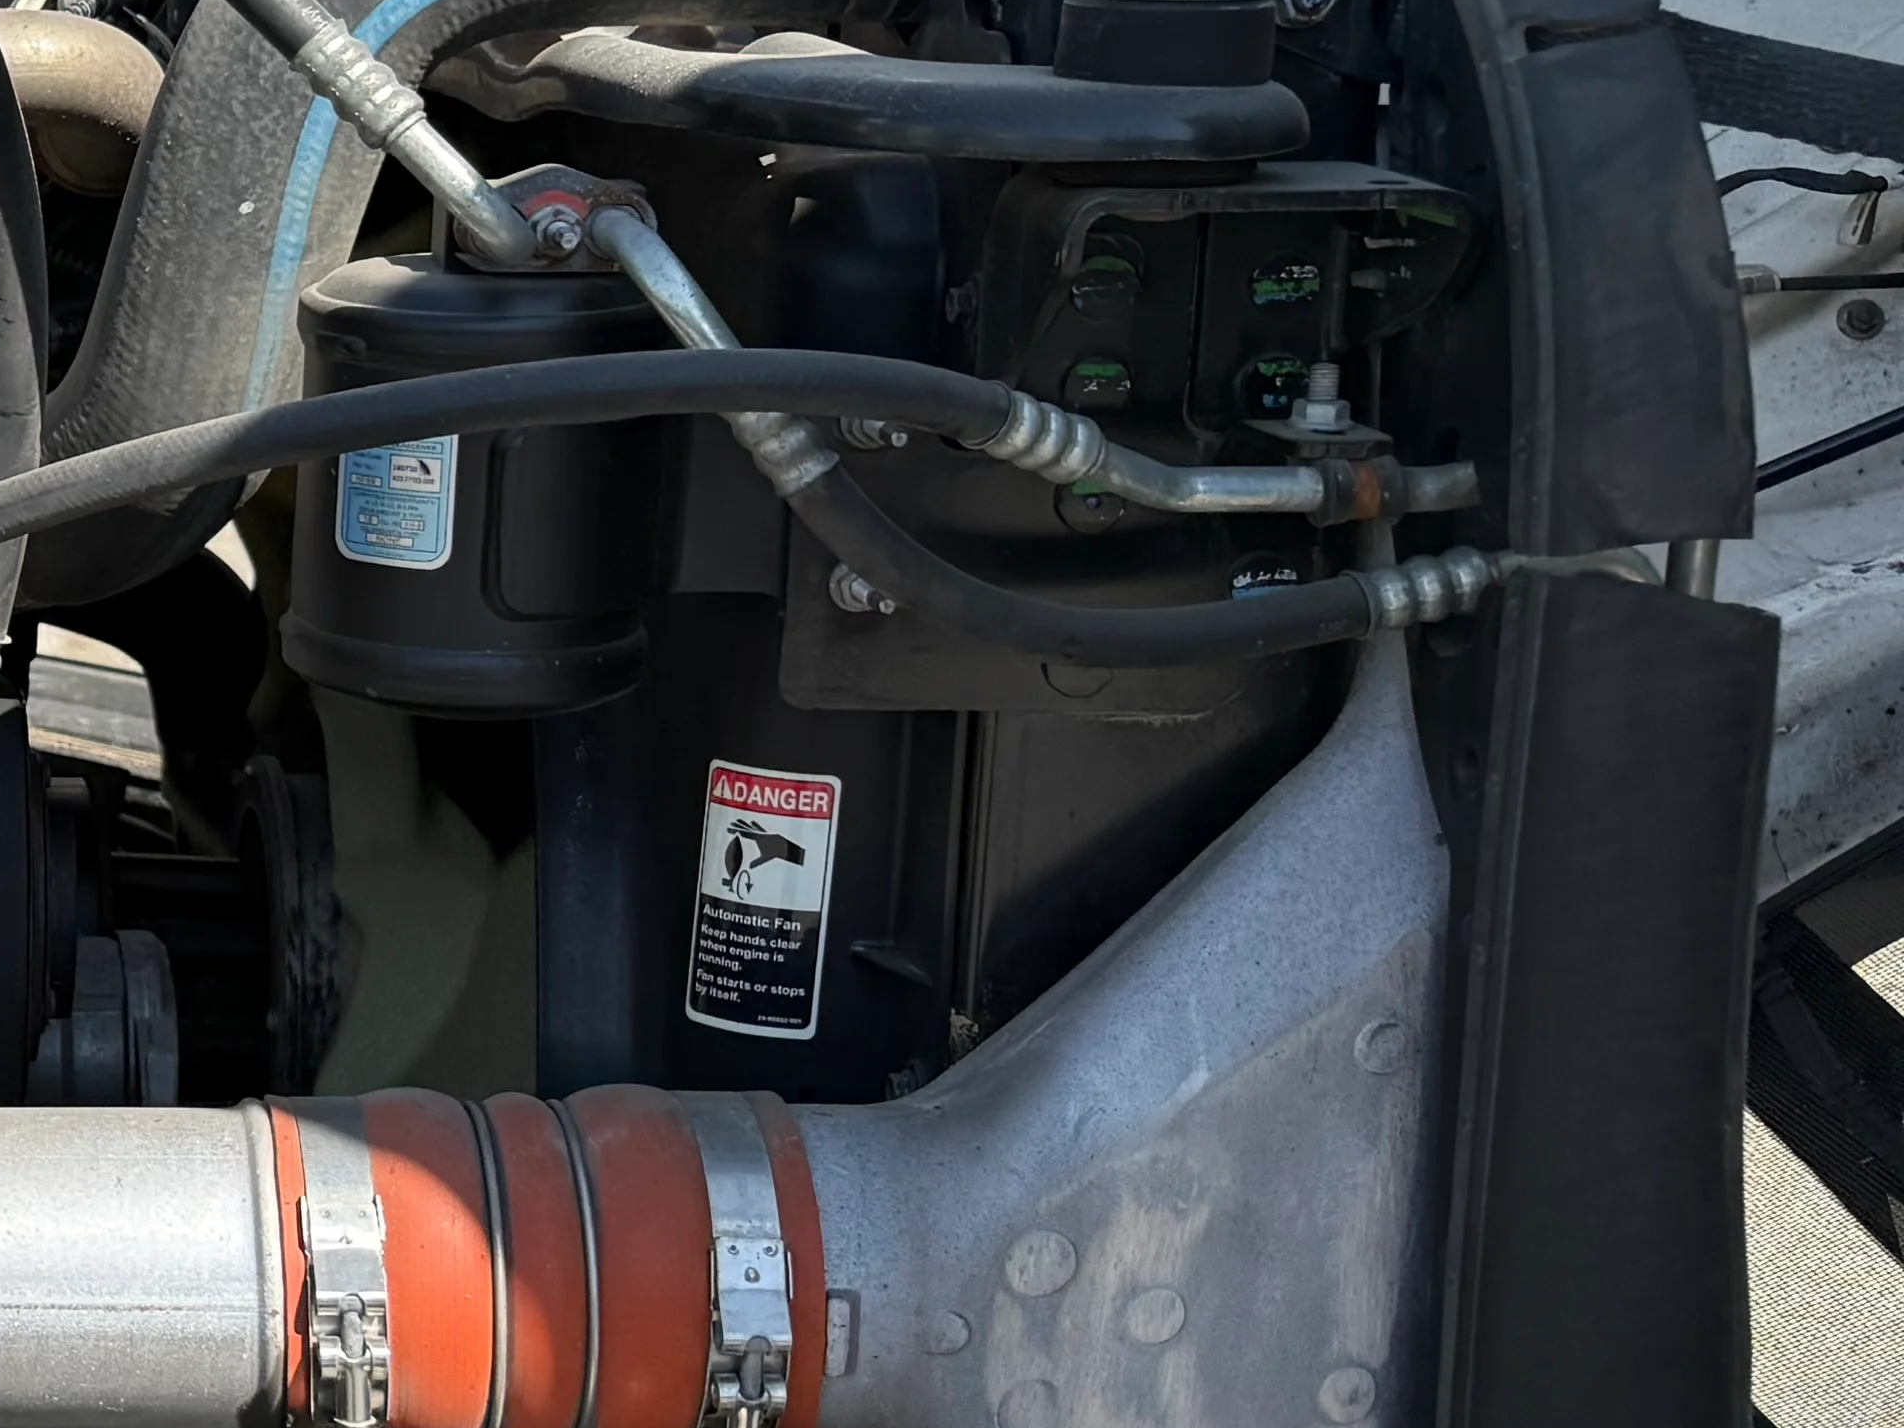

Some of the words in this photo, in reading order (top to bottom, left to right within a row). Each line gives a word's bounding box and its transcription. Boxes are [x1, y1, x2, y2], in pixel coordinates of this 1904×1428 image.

[733, 780, 829, 813] DANGER
[702, 903, 770, 928] Automatic
[774, 917, 801, 932] Fan
[700, 923, 727, 941] Keep
[729, 931, 767, 947] hands
[769, 938, 802, 950] clear
[698, 952, 743, 972] running.
[699, 938, 727, 953] when
[729, 945, 770, 962] engine
[773, 950, 785, 963] is
[695, 981, 708, 996] by
[709, 985, 741, 1003] itself.
[696, 968, 714, 982] Fan
[716, 975, 752, 991] starts
[753, 983, 768, 993] or
[770, 984, 806, 998] stops
